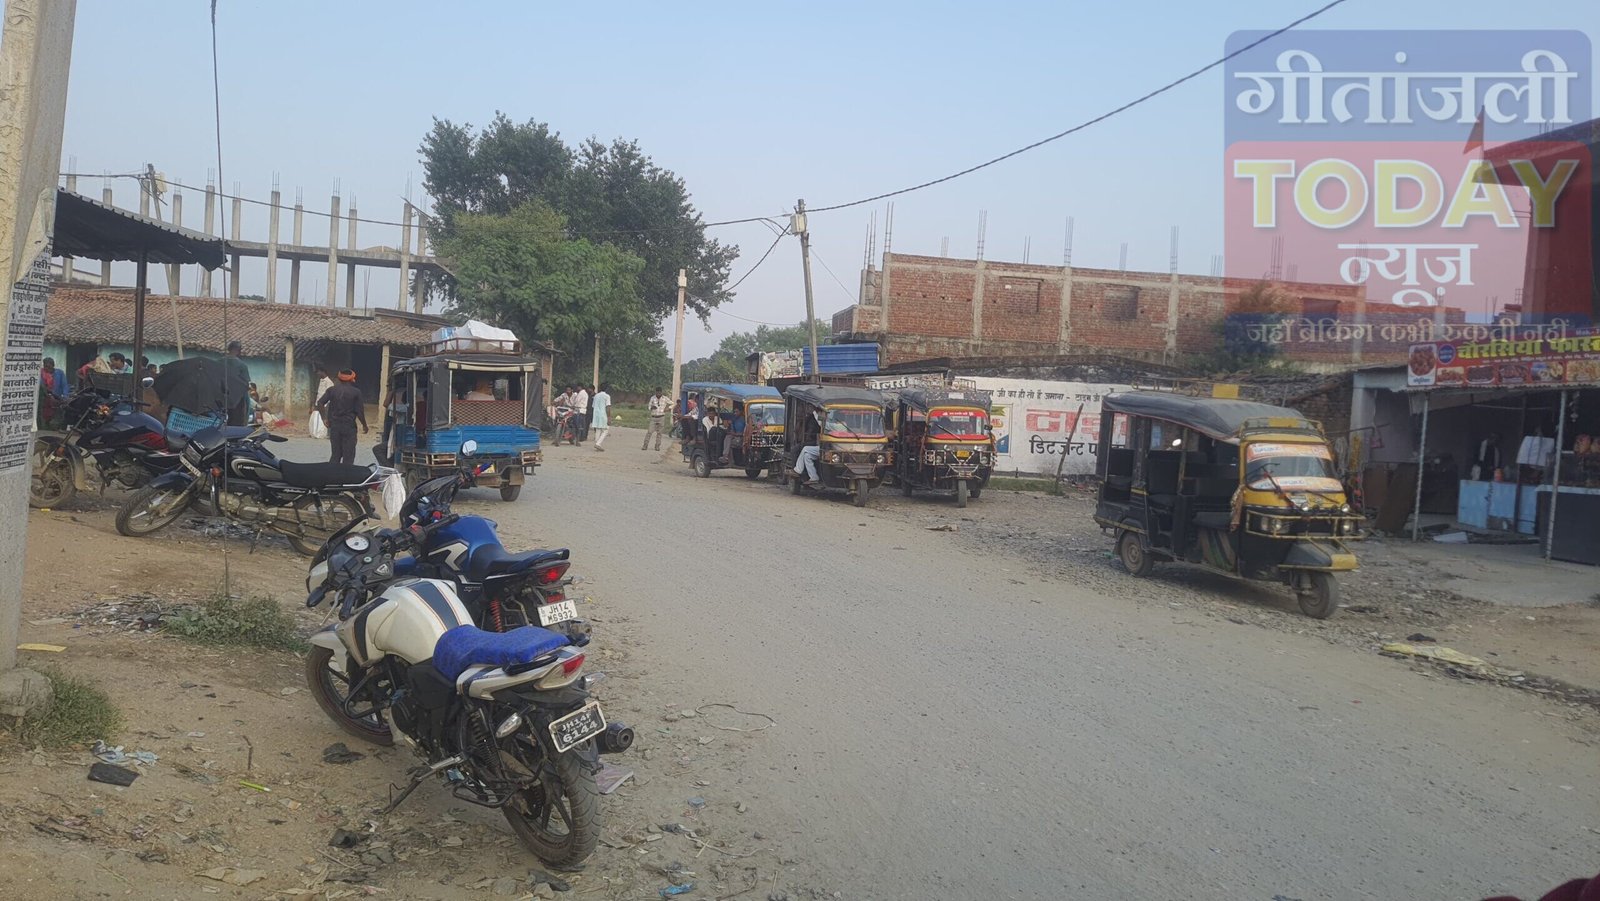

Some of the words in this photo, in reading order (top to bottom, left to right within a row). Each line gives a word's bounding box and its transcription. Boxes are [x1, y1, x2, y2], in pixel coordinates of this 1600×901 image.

[548, 603, 569, 614] JH14
[547, 610, 574, 623] M6932
[563, 720, 598, 743] 6144
